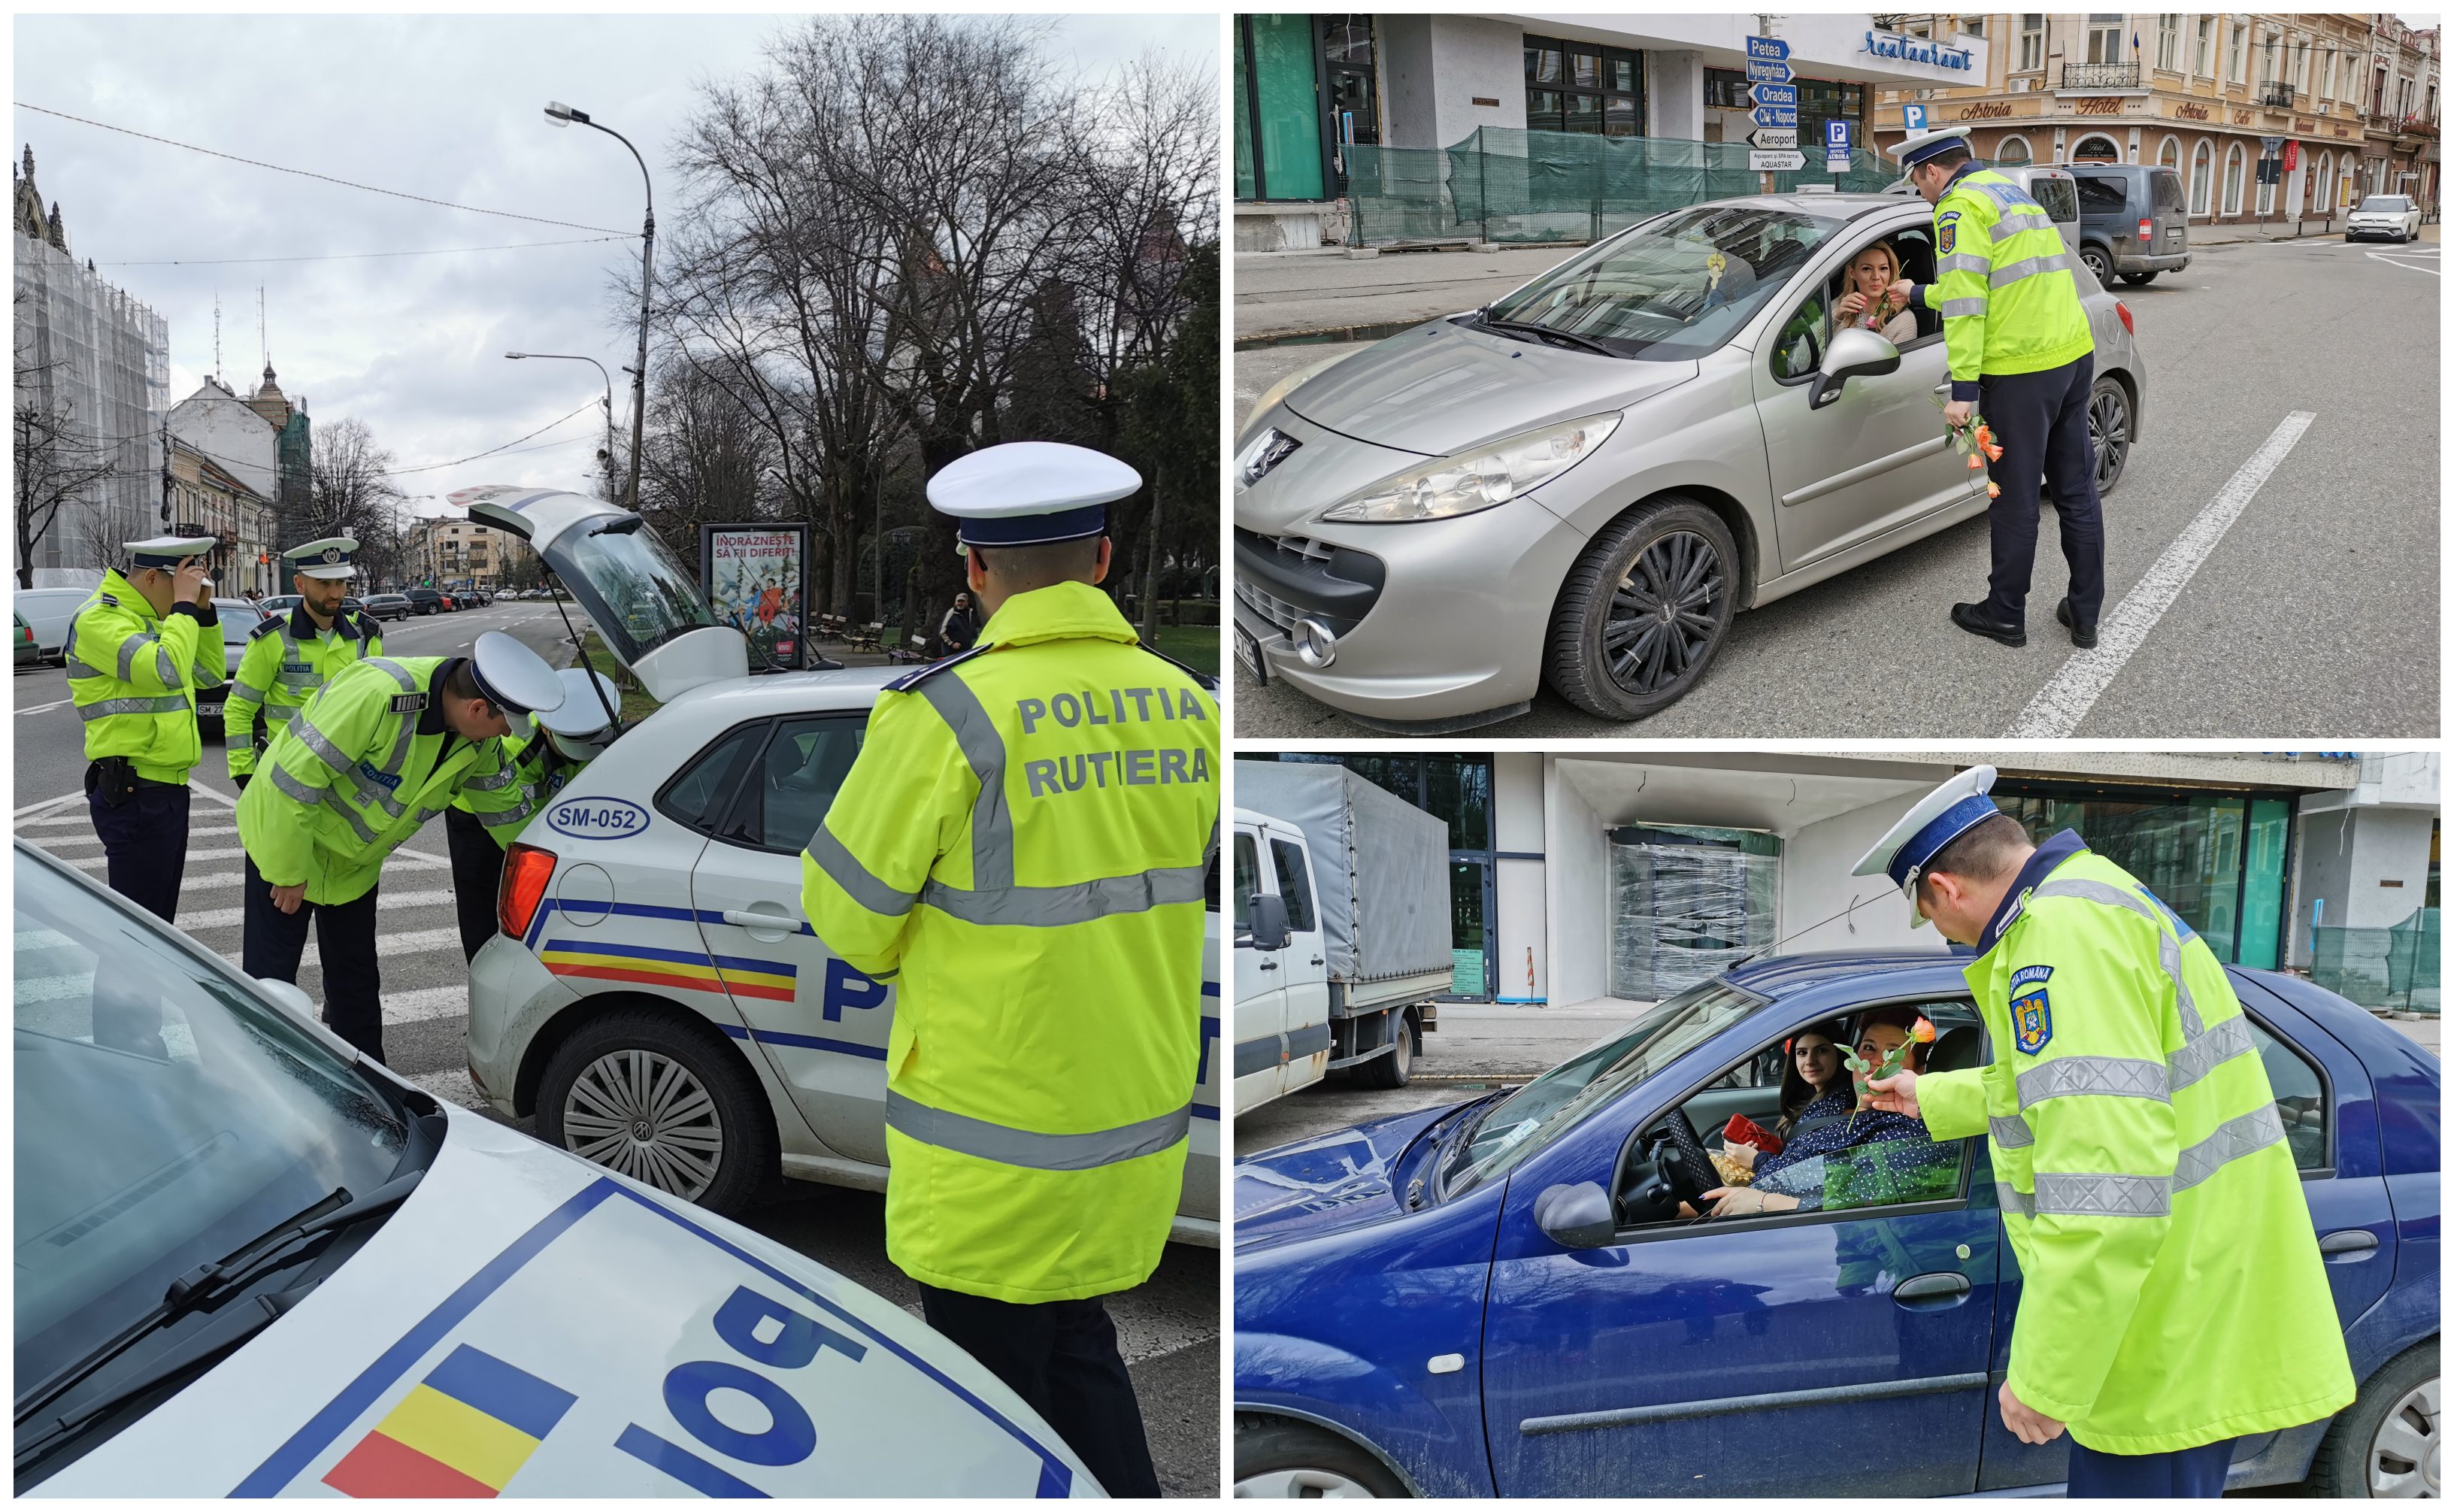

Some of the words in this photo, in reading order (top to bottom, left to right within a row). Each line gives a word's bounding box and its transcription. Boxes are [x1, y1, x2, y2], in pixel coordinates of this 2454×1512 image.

[1752, 40, 1780, 56] Petea
[1859, 31, 1975, 71] restaurant
[1762, 87, 1793, 102] Oradea
[1961, 102, 2012, 120] Astoria
[2076, 96, 2123, 115] Hotel
[2176, 102, 2210, 121] Astoria
[1775, 109, 1796, 126] Napoca
[1907, 107, 1922, 127] P
[1761, 134, 1795, 147] Aeroport
[1834, 126, 1844, 139] P
[717, 535, 795, 547] ÎNDRĂZNEȘTE
[717, 547, 731, 558] SĂ
[734, 549, 746, 558] FII
[750, 548, 795, 558] DIFERIT!
[198, 706, 211, 714] SM
[1016, 687, 1207, 735] POLITIA
[362, 763, 398, 788] POLITIA
[1024, 748, 1210, 798] RUTIERA
[557, 808, 636, 829] SM-052
[2020, 966, 2051, 980] ROMÂNĂ
